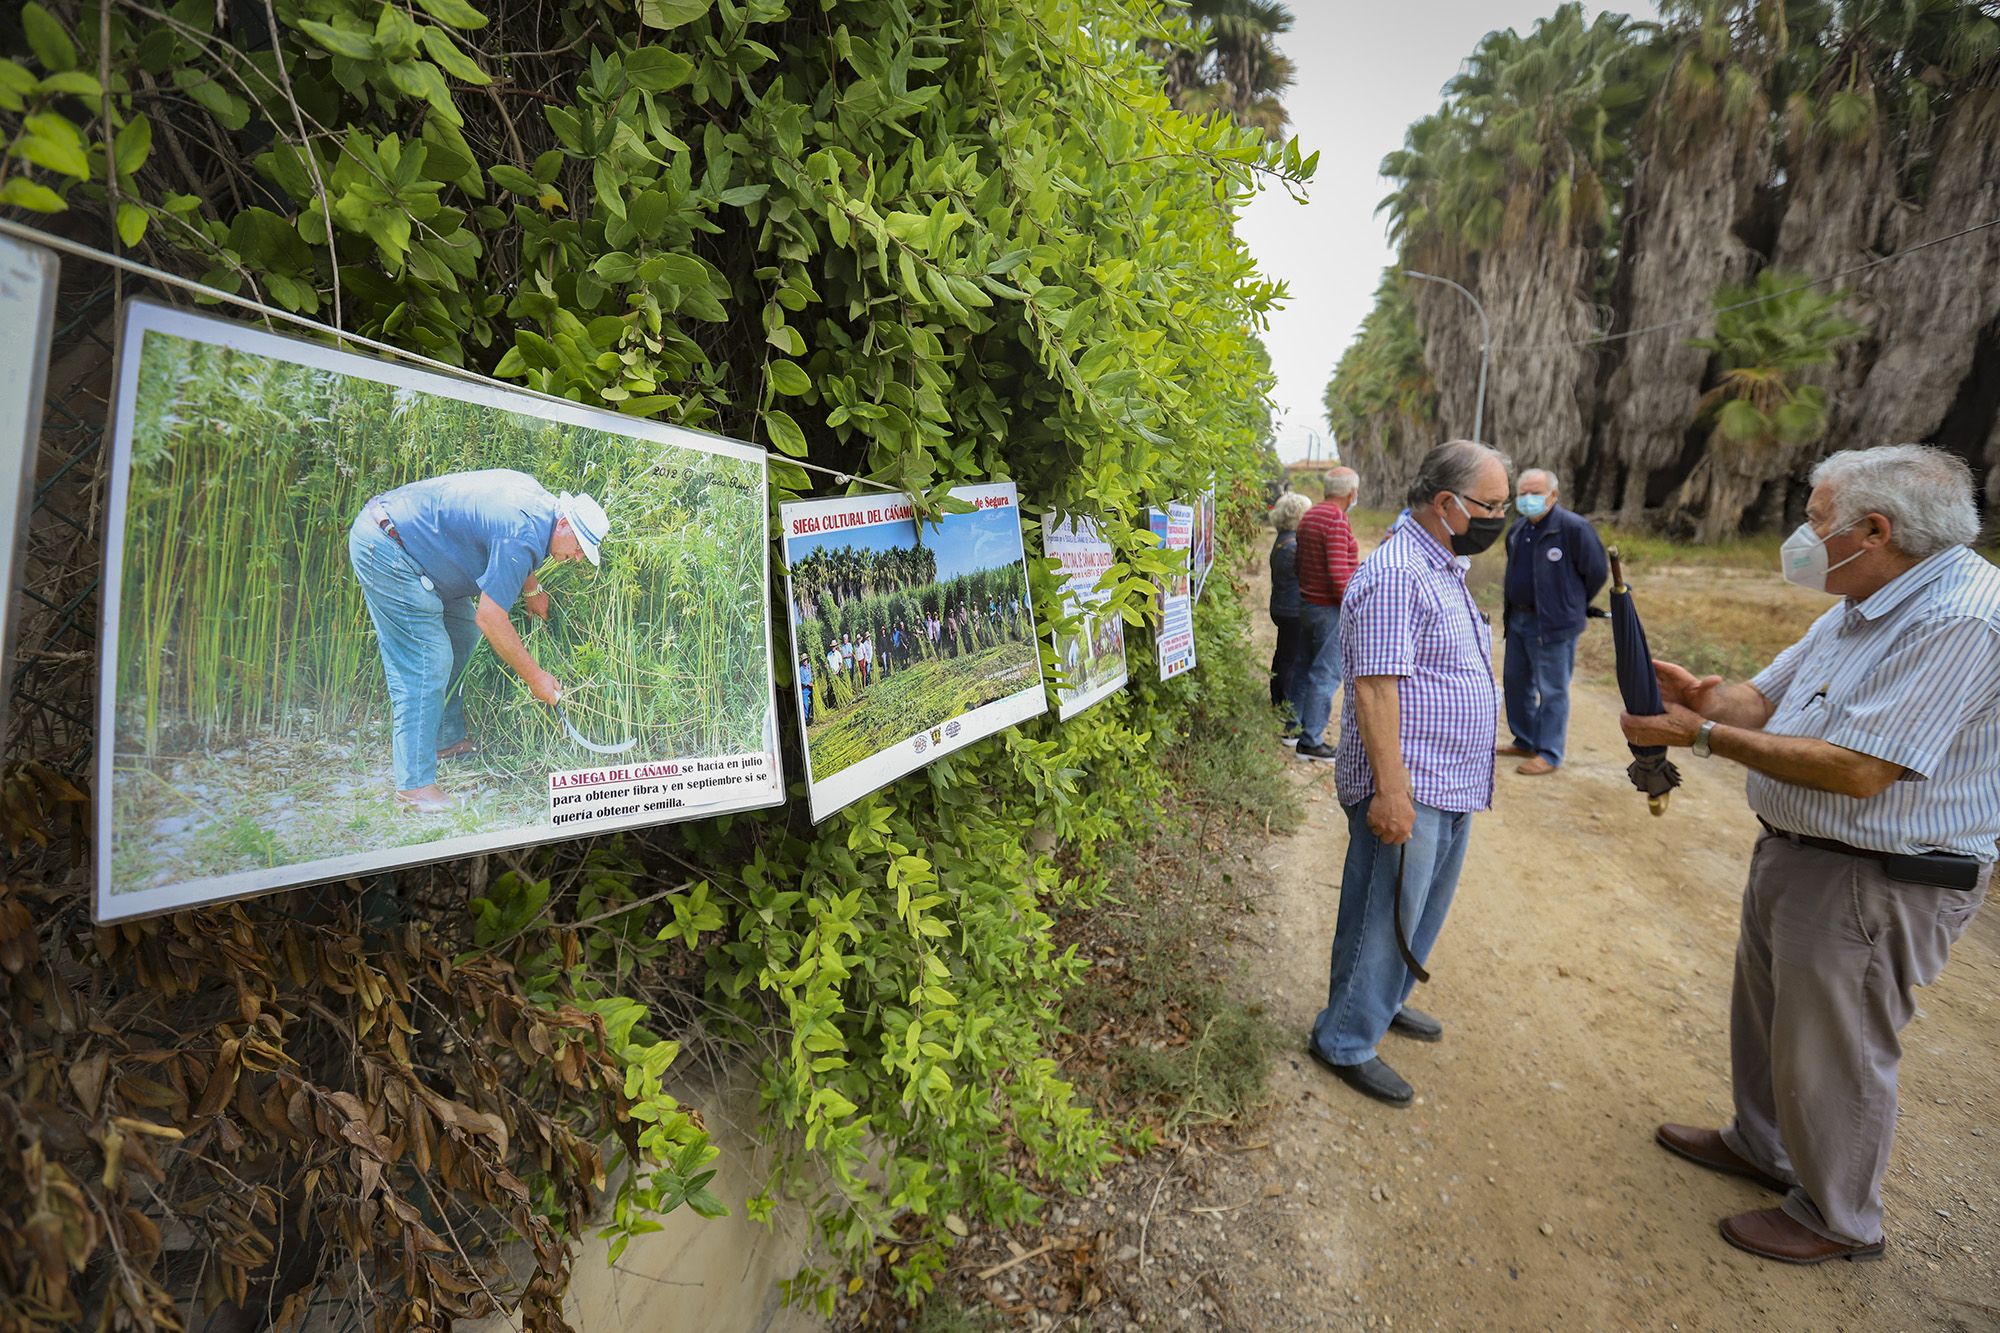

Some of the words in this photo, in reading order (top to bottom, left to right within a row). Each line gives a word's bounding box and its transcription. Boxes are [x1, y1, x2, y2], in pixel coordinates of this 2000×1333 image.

[652, 466, 678, 479] 2012
[792, 517, 820, 535] SIEGA
[822, 511, 866, 530] CULTURAL
[867, 509, 883, 524] DEL
[975, 497, 983, 508] de
[985, 496, 1009, 509] Segura
[552, 776, 567, 787] LA
[571, 771, 606, 785] SIEGA
[609, 769, 631, 781] DEL
[634, 764, 679, 778] CÁÑAMO
[682, 764, 694, 773] se
[727, 760, 739, 768] en
[741, 757, 763, 769] julio
[553, 794, 581, 807] para
[585, 787, 630, 802] obtener
[633, 784, 659, 796] fibra
[662, 784, 668, 794] y
[671, 782, 684, 791] en
[687, 775, 742, 790] septiembre
[745, 773, 753, 782] si
[756, 773, 767, 781] se
[552, 809, 593, 826] quería
[596, 804, 641, 818] obtener
[643, 798, 686, 812] semilla.
